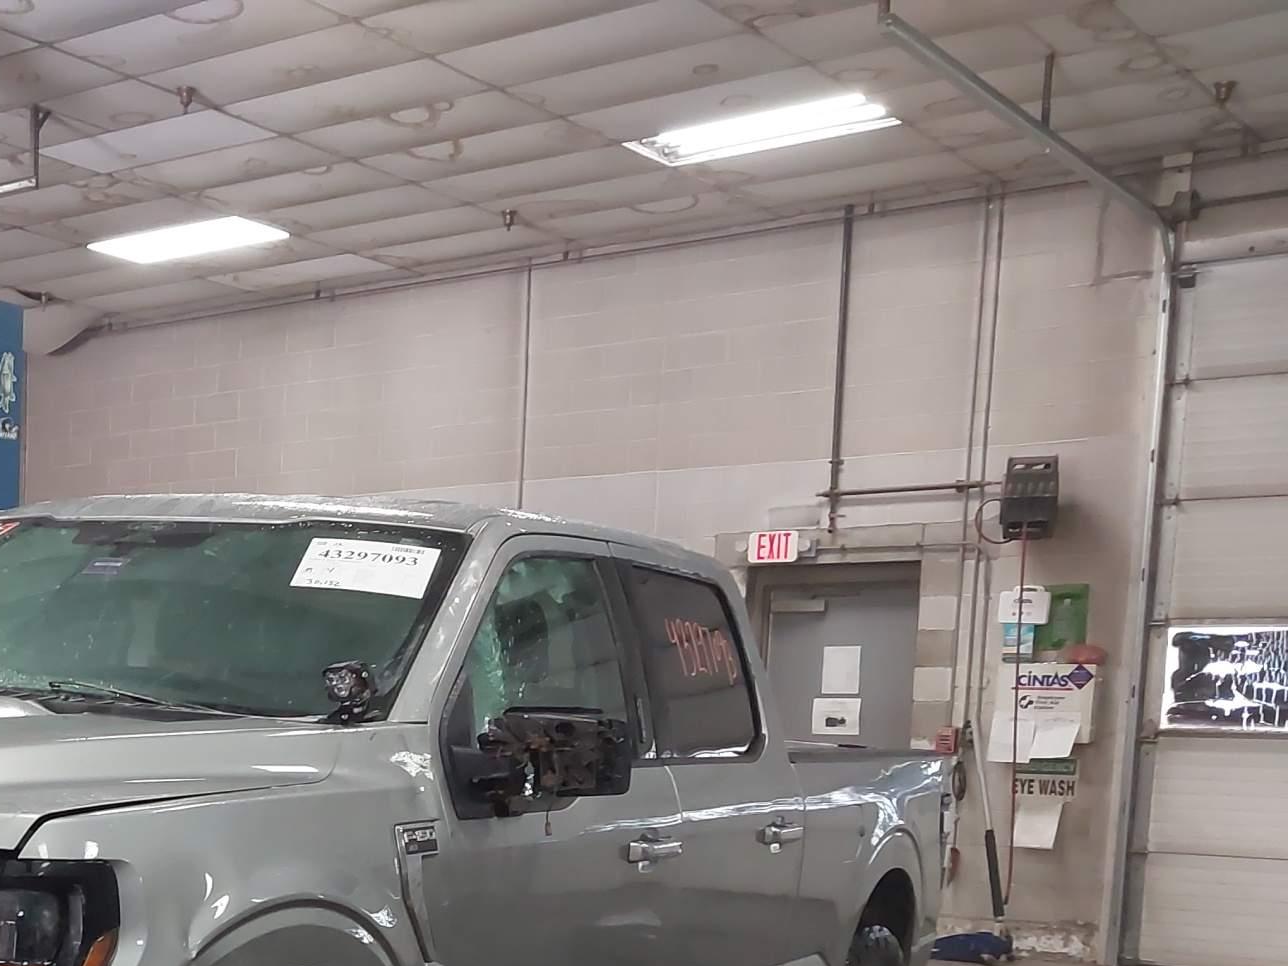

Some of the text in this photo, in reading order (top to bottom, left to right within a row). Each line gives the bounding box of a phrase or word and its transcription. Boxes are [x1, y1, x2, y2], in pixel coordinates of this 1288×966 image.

[757, 533, 792, 560] EXIT
[317, 549, 419, 567] 43297093
[1038, 779, 1075, 796] WASH
